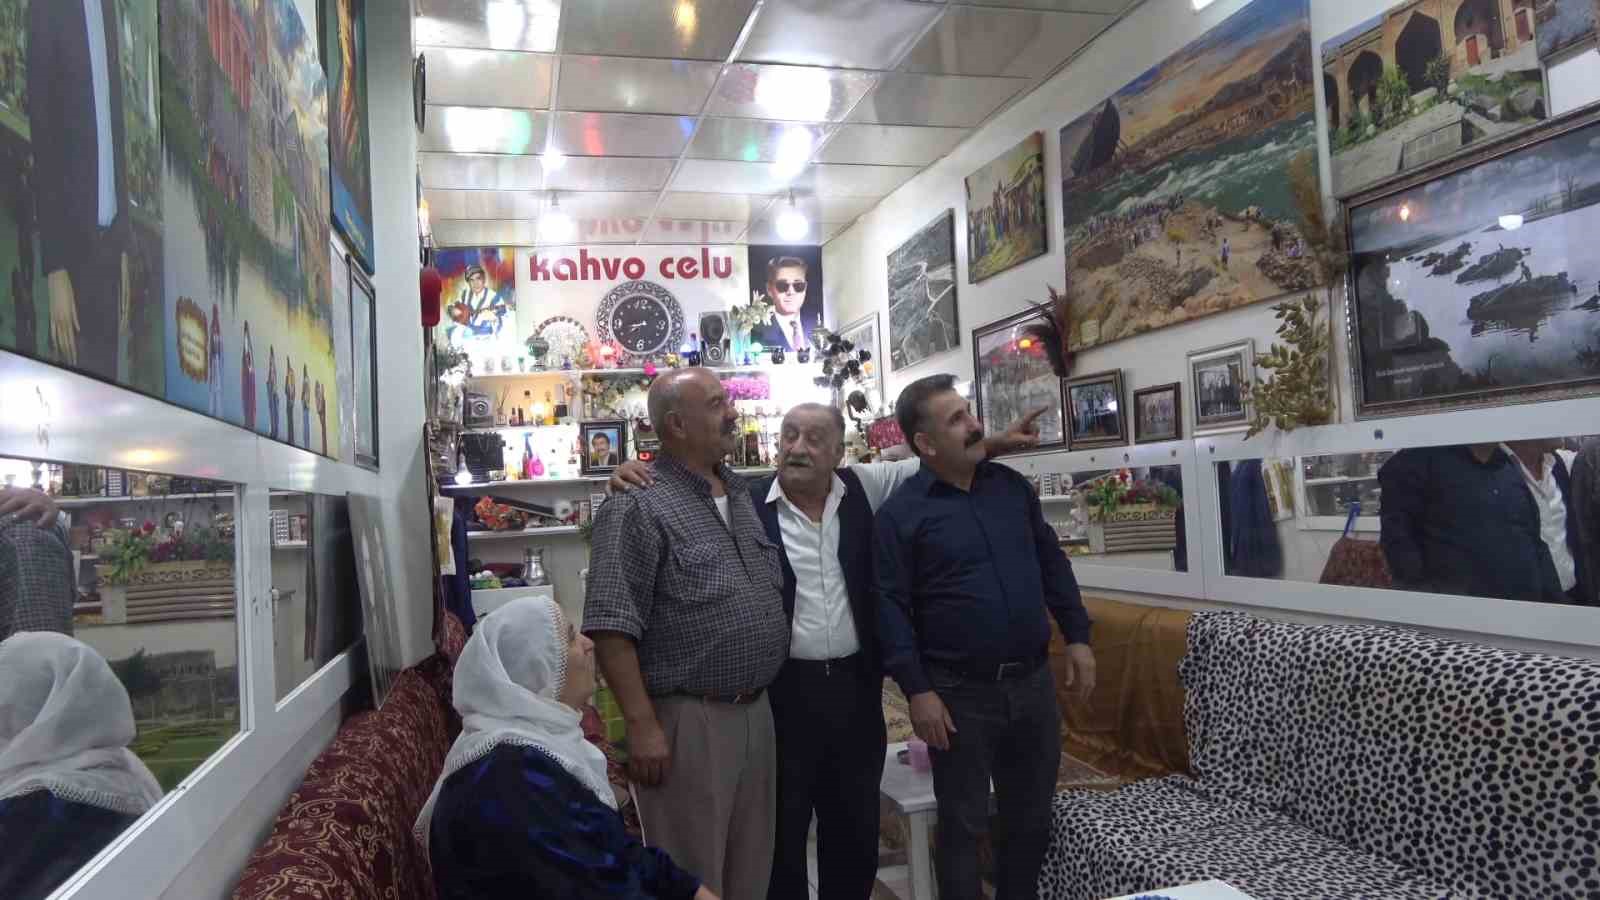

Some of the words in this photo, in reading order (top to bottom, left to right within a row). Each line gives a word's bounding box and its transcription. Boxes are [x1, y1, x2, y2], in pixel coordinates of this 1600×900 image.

[529, 248, 646, 281] kahvo
[659, 247, 733, 280] celu
[636, 339, 645, 351] 6
